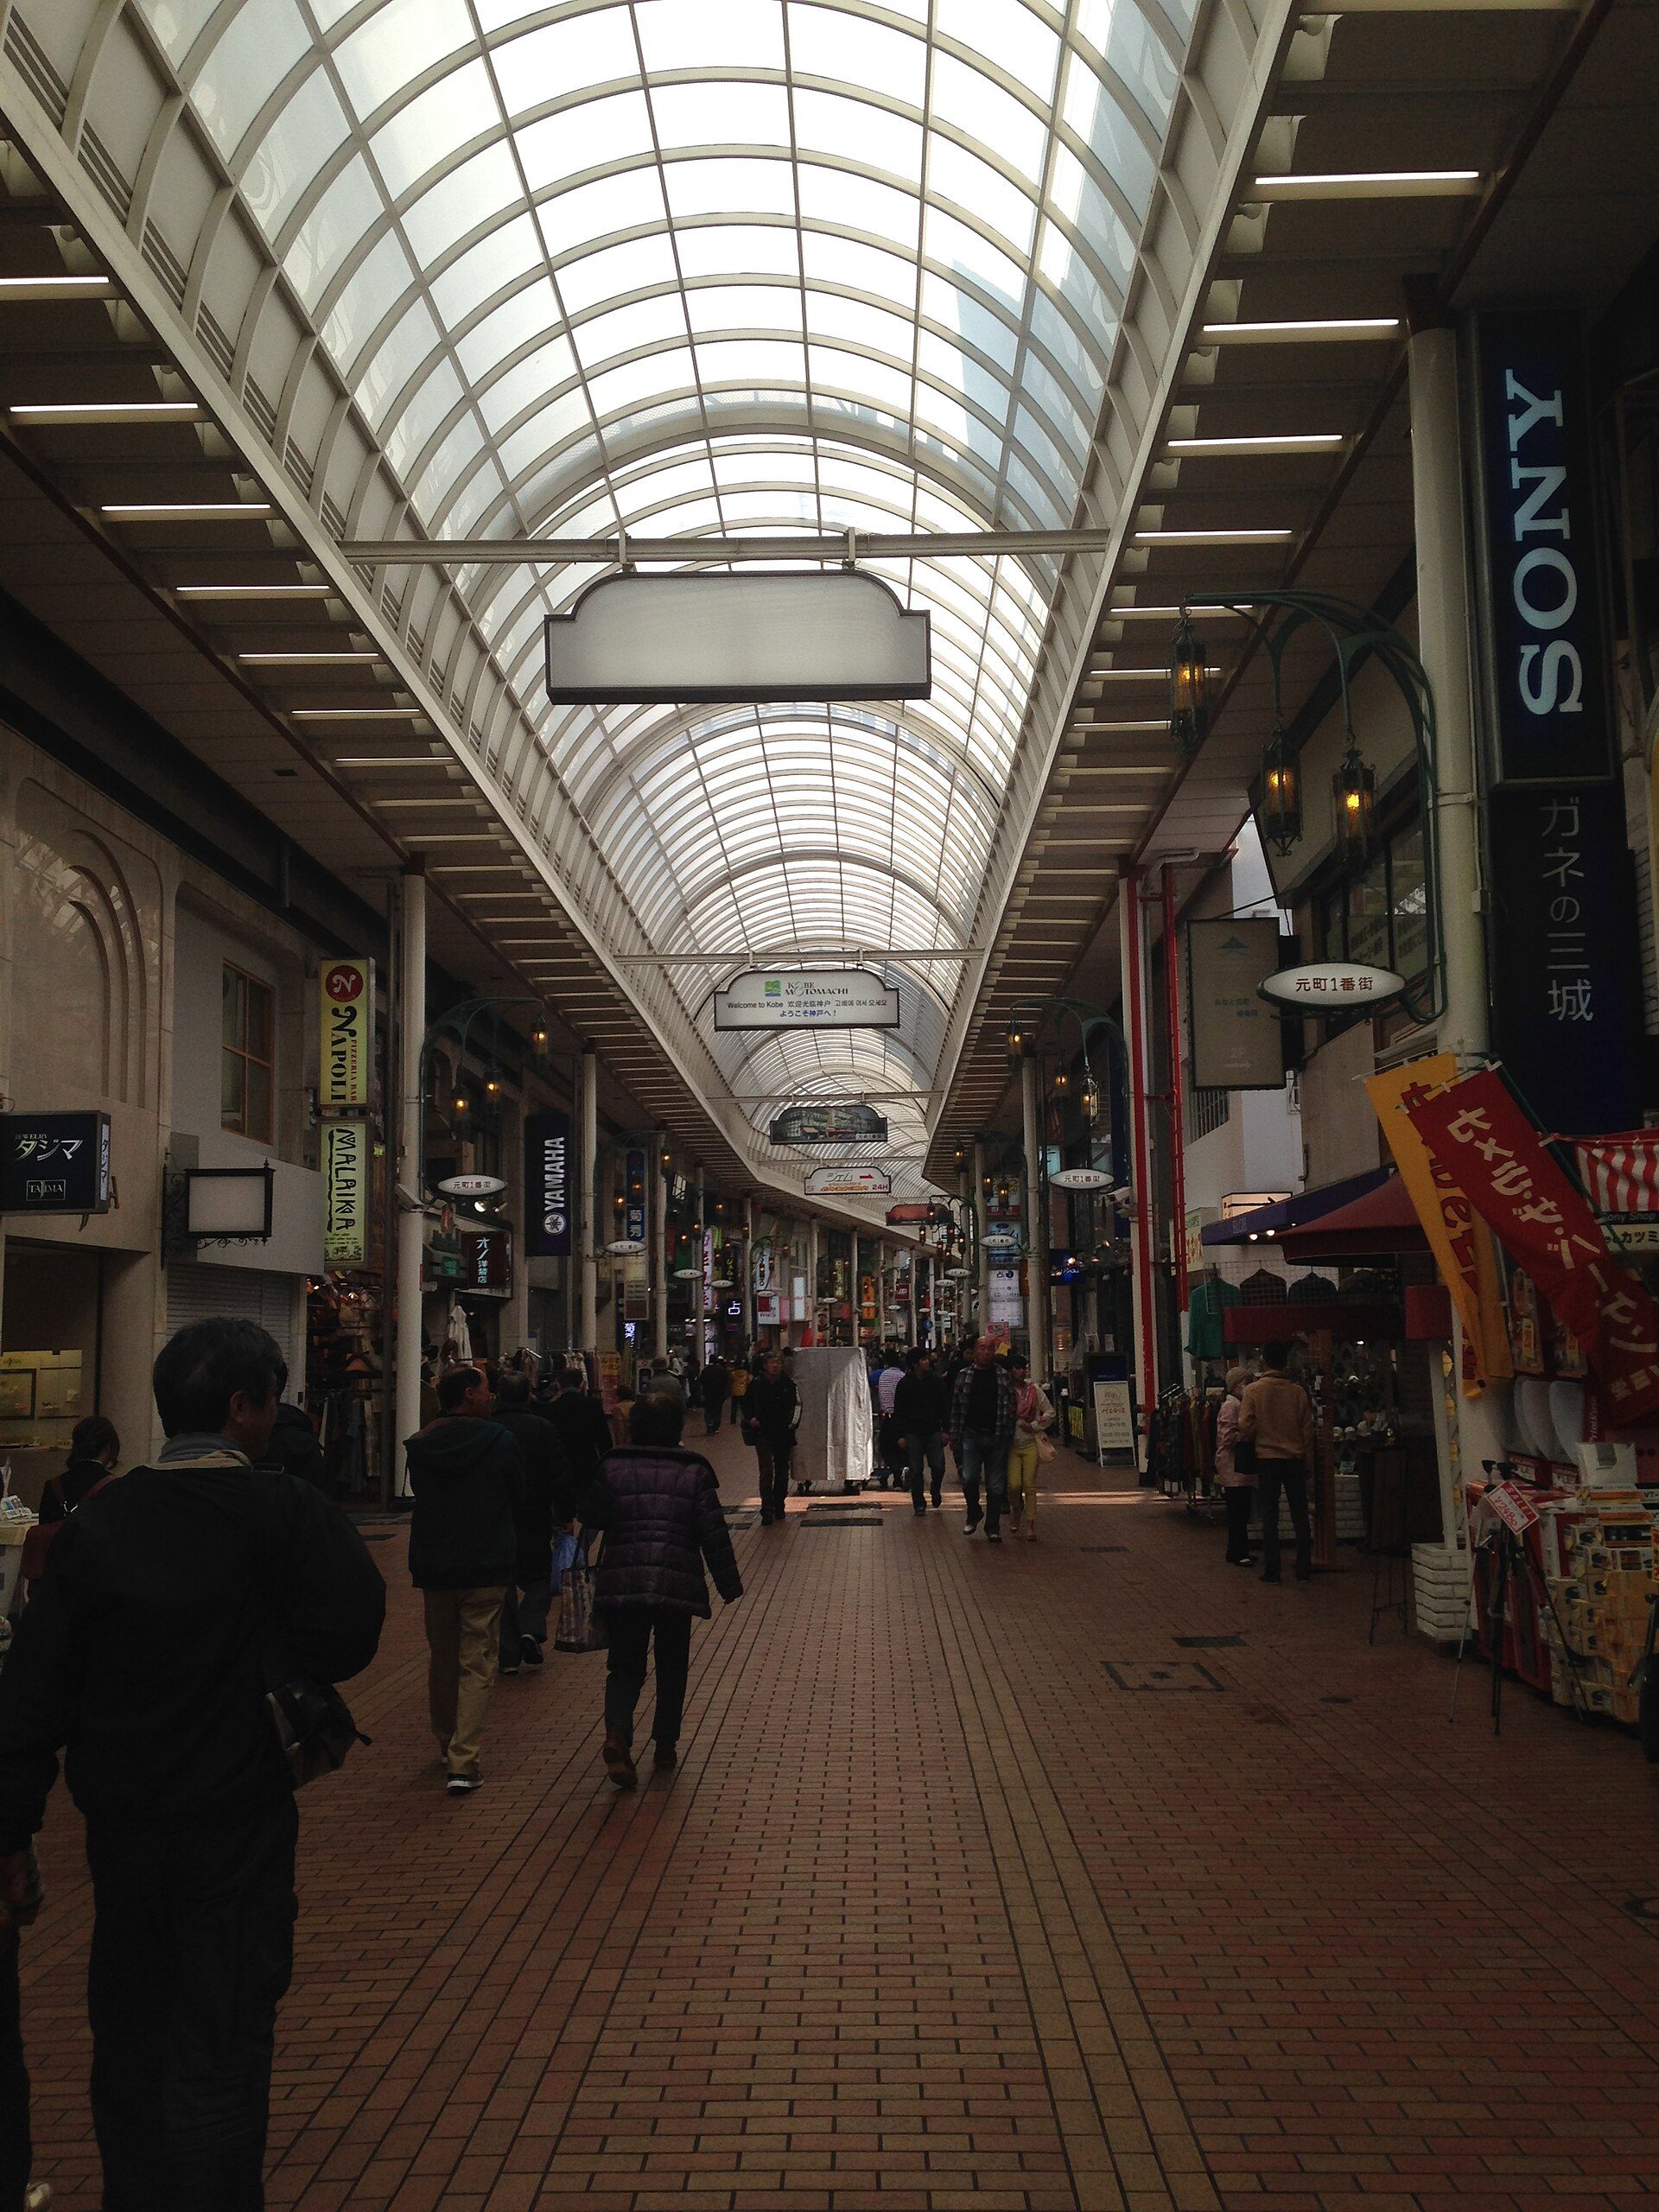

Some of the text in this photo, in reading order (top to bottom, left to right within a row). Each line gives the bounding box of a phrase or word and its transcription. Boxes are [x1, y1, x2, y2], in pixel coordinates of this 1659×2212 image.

[1505, 369, 1584, 716] SONY
[1539, 795, 1594, 1023] ガネの三城
[785, 986, 849, 996] MOTOMACHI
[1295, 976, 1374, 992] 元町1番街
[331, 1005, 358, 1102] NAPOLI
[15, 1139, 84, 1162] タジマ
[334, 1128, 357, 1231] MALAIKA
[453, 1180, 491, 1189] 元町1番街
[543, 1136, 565, 1211] YAMAHA
